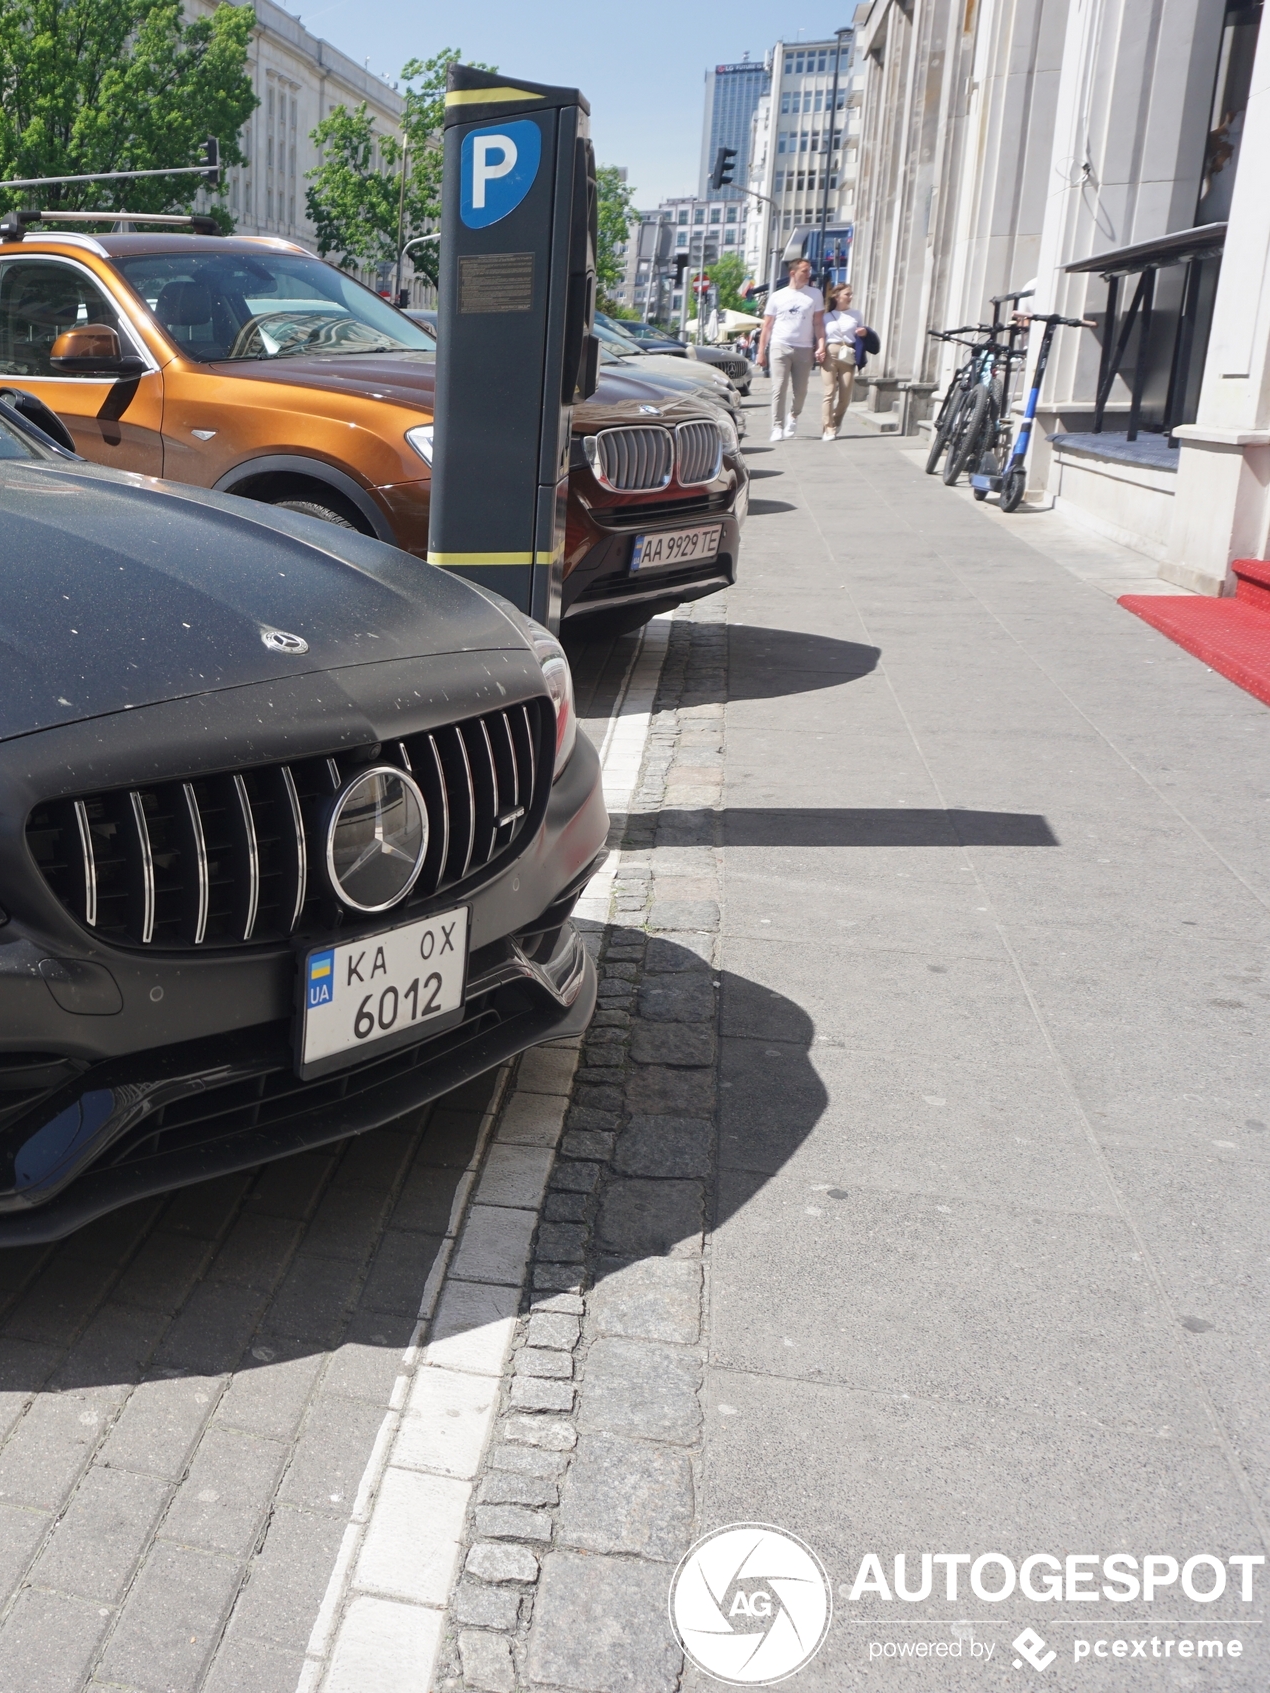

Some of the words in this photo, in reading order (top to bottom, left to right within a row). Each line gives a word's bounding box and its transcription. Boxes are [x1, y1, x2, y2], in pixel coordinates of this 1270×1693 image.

[472, 134, 518, 209] P
[641, 538, 663, 563] AA
[666, 533, 699, 559] 9929
[701, 529, 719, 553] TE
[347, 945, 387, 986] KA
[420, 921, 456, 960] OX
[310, 984, 330, 1004] UA
[354, 971, 443, 1039] 6012
